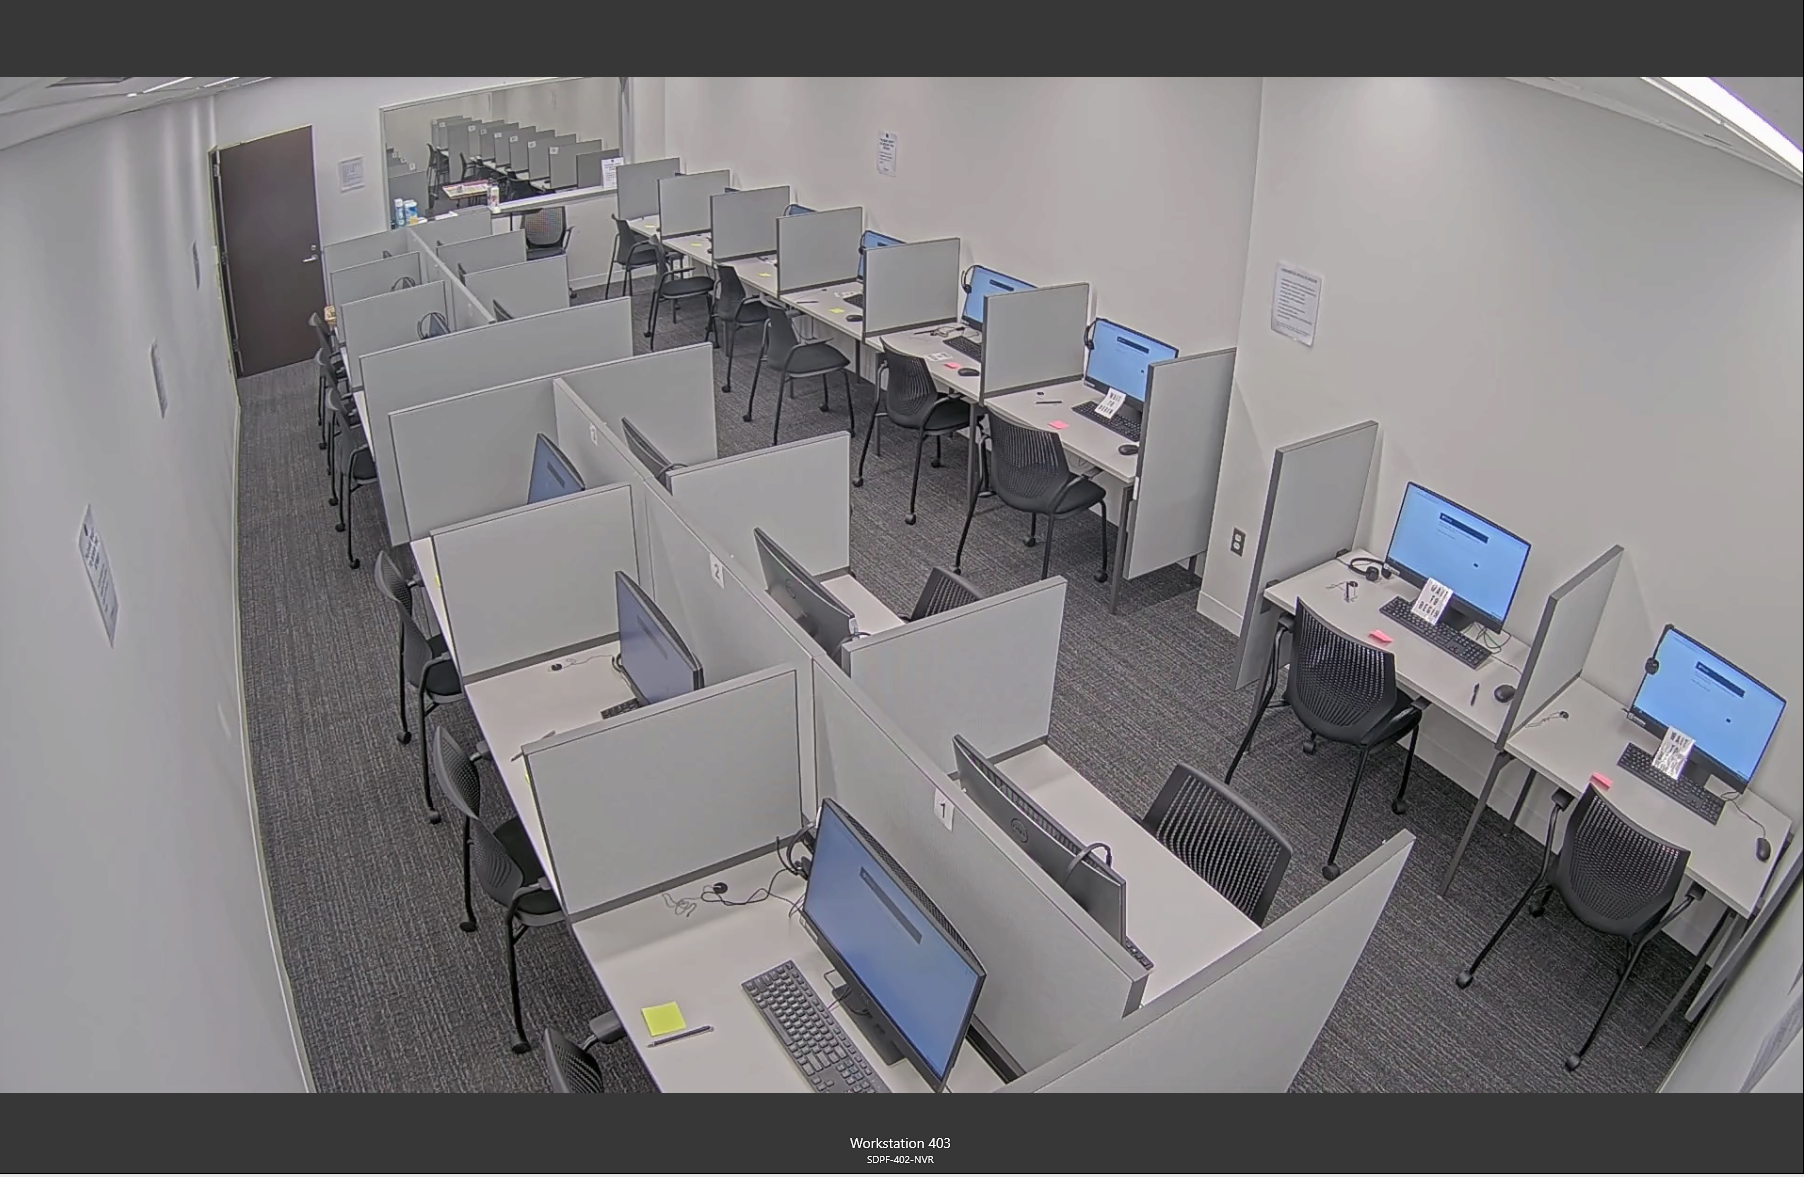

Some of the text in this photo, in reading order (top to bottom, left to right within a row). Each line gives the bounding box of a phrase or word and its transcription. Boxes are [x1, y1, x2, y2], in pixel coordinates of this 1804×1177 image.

[714, 563, 720, 579] 2
[1430, 584, 1449, 599] WAIT
[1429, 595, 1440, 606] TO
[1418, 601, 1440, 618] BEGIN
[1670, 731, 1690, 748] WAIT
[940, 802, 946, 818] 1
